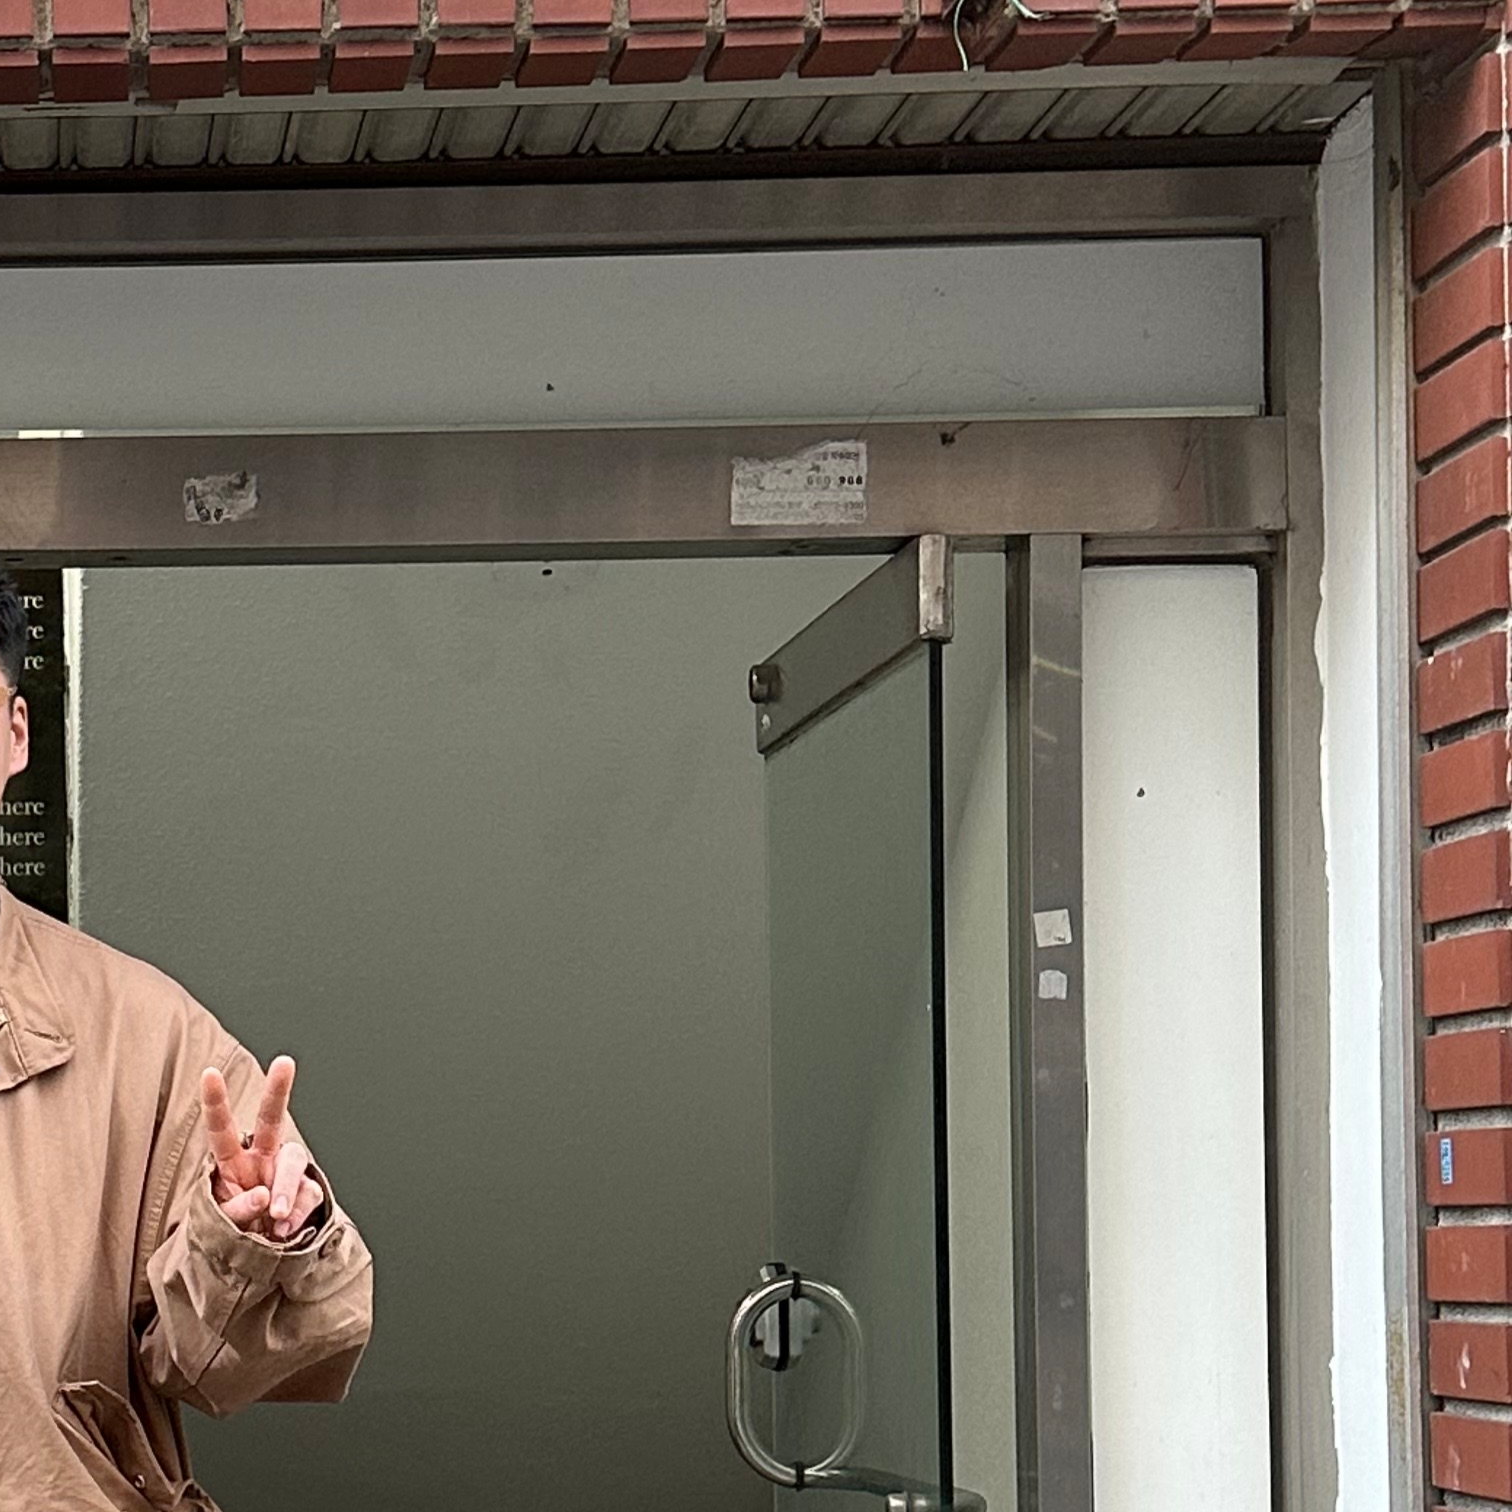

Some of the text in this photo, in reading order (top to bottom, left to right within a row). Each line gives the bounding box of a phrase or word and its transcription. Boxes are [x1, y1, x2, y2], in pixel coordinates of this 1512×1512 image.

[19, 595, 45, 610] re
[24, 625, 45, 641] re
[23, 655, 45, 670] re
